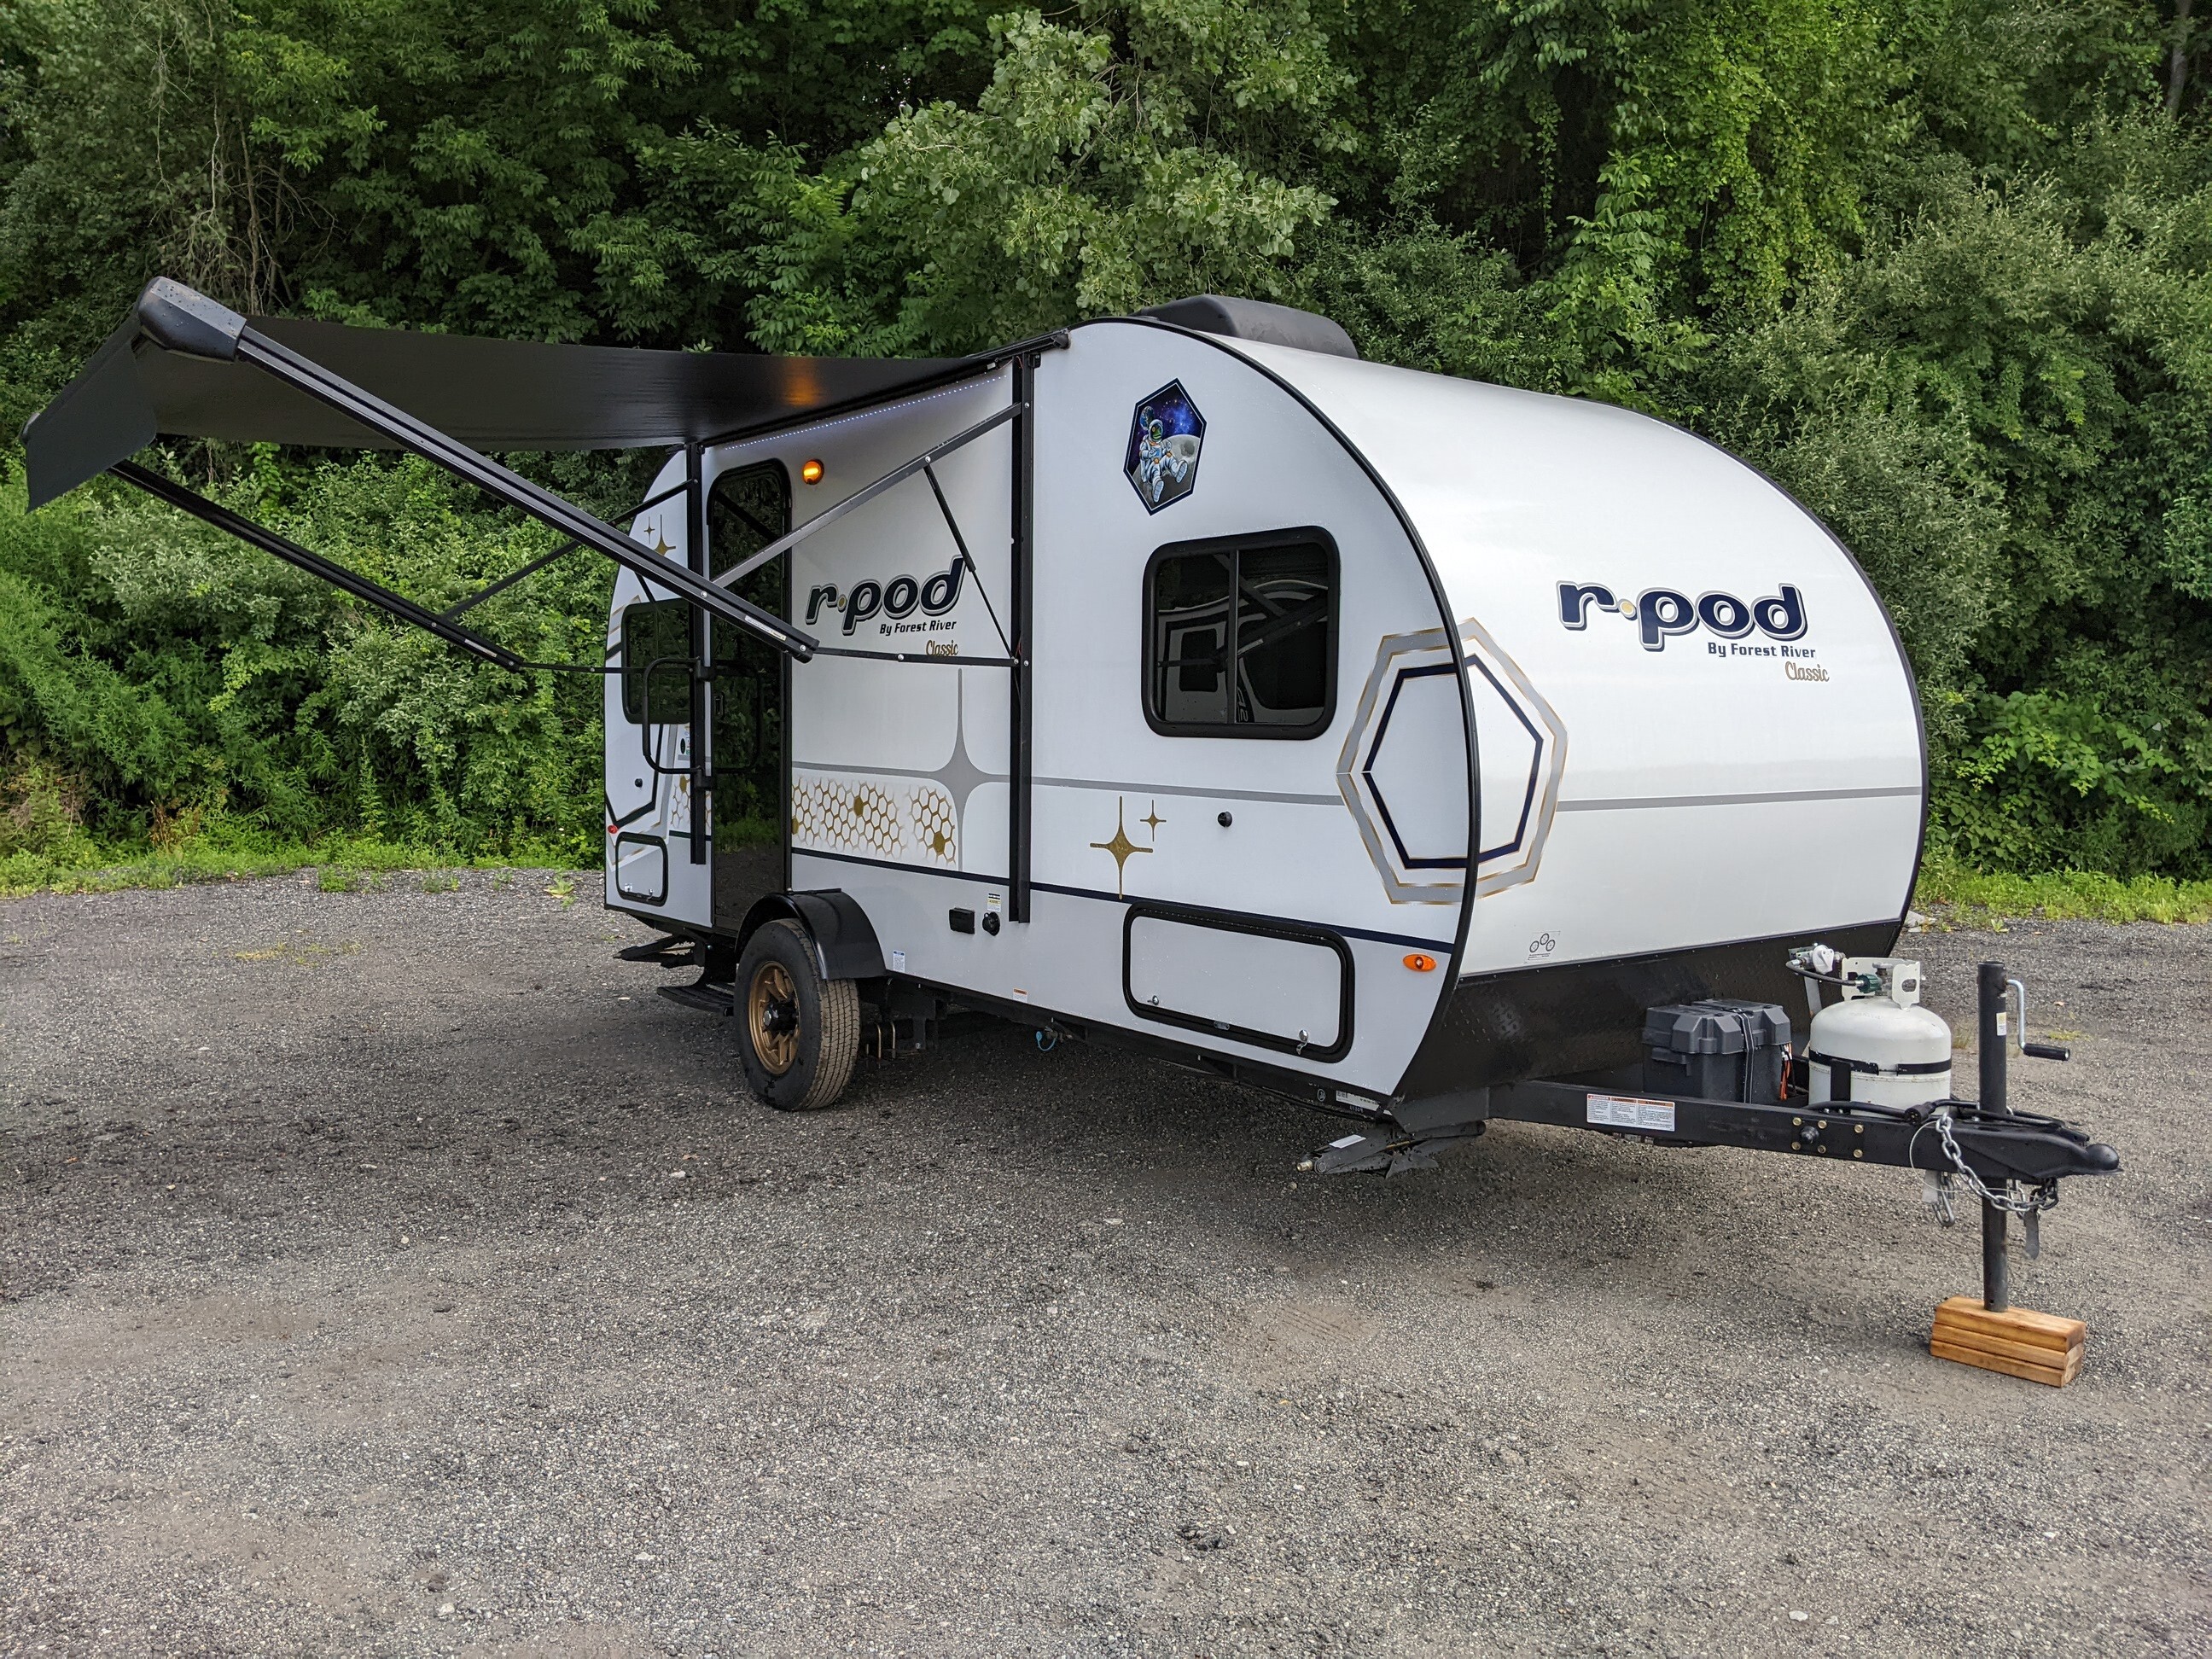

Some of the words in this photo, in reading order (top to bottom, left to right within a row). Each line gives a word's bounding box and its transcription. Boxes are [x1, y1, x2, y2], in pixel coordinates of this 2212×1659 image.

[879, 624, 892, 636] By
[894, 623, 927, 633] Forest
[929, 620, 957, 631] River
[926, 639, 958, 655] Classic
[1708, 642, 1726, 657] By
[1731, 643, 1778, 656] Forest
[1781, 645, 1816, 658] River
[1785, 661, 1830, 682] Classic
